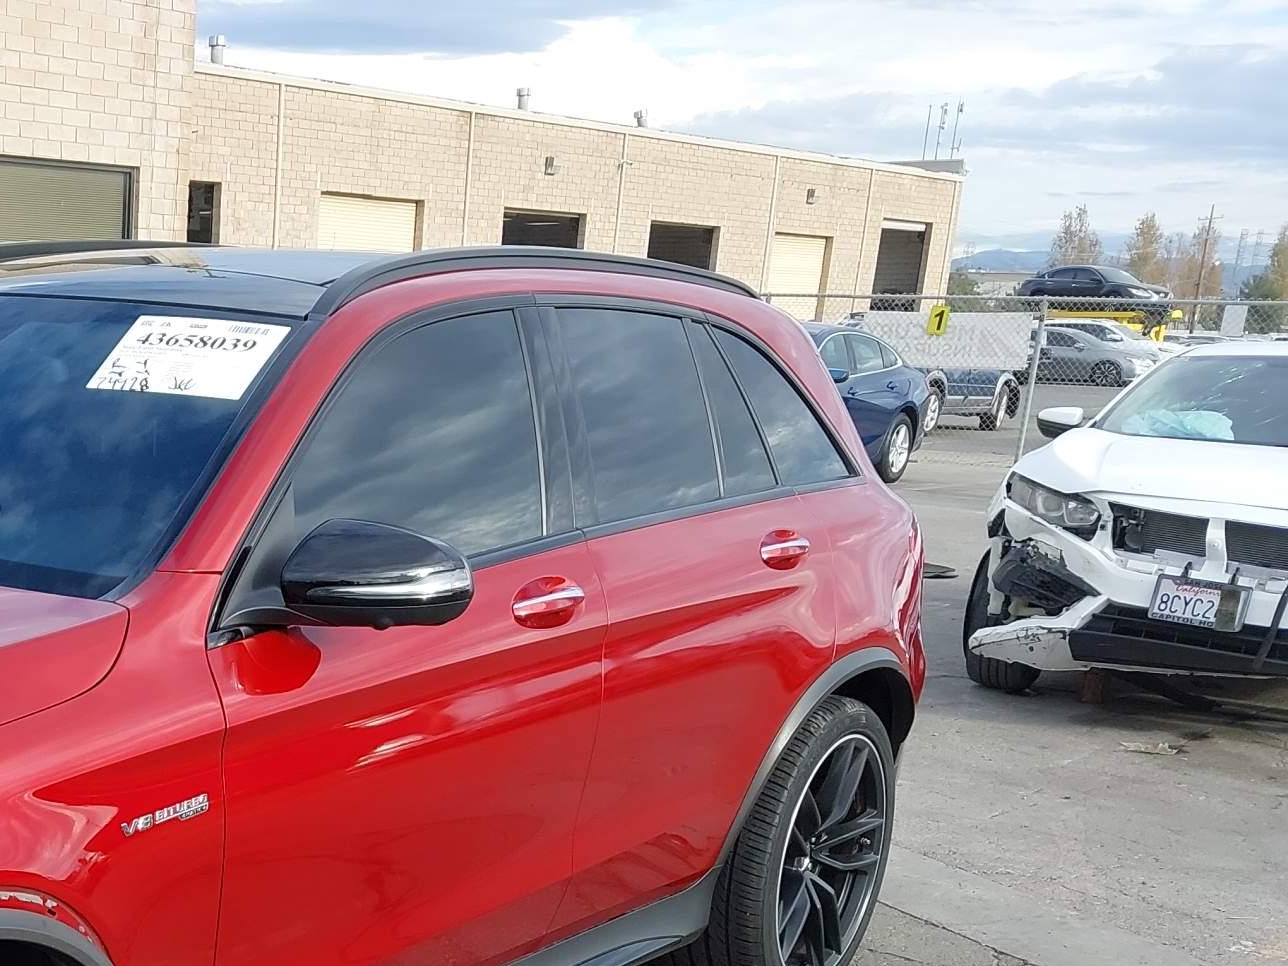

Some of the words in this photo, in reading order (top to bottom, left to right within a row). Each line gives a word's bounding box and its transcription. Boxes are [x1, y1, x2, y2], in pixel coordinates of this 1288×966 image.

[933, 309, 946, 331] 1
[135, 331, 258, 352] 43658039
[1151, 612, 1194, 625] CAPITOL
